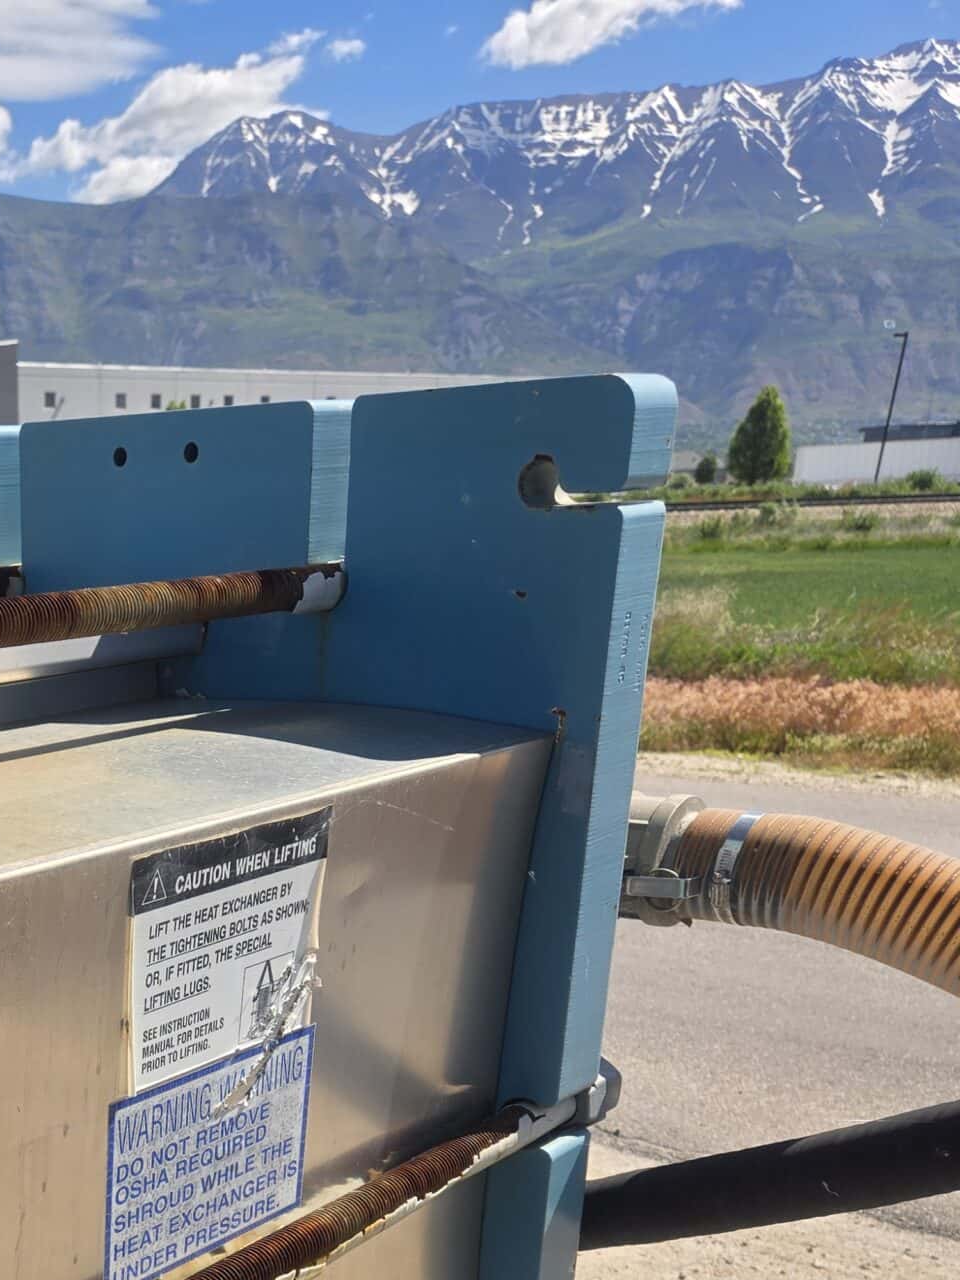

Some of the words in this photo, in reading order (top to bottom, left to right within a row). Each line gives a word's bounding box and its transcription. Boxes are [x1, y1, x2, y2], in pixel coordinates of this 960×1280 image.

[175, 861, 231, 894] CAUTION
[236, 850, 271, 876] WHEN
[274, 837, 316, 864] LIFTING
[147, 944, 166, 963] THE
[170, 925, 226, 956] TIGHTENING
[230, 914, 259, 936] BOLTS
[261, 910, 273, 926] AS
[149, 920, 170, 940] LIFT
[173, 913, 192, 932] THE
[194, 904, 219, 925] HEAT
[221, 886, 278, 916] EXCHANGER
[280, 881, 293, 898] BY
[145, 971, 162, 988] OR,
[165, 965, 174, 981] IF
[177, 953, 212, 977] FITTED,
[215, 945, 233, 963] THE
[235, 932, 272, 957] SPECIAL
[144, 986, 180, 1012] LIFTING
[183, 976, 211, 997] LUGS.
[142, 1037, 174, 1059] MANUAL
[177, 1030, 192, 1046] FOR
[194, 1017, 224, 1039] DETAILS
[143, 1026, 158, 1043] SEE
[160, 1007, 210, 1037] INSTRUCTION
[141, 1055, 166, 1074] PRIOR
[168, 1050, 178, 1064] TO
[180, 1038, 211, 1059] LIFTING.
[118, 1083, 212, 1154] WARNING
[220, 1046, 303, 1103] WNING
[115, 1168, 169, 1205] OSHA
[176, 1125, 266, 1179] REQUIRED
[117, 1157, 144, 1184] DO
[151, 1136, 190, 1168] NOT
[196, 1101, 270, 1149] REMOVE
[114, 1183, 194, 1233] SHROUD
[200, 1154, 255, 1193] WHILE
[261, 1137, 293, 1164] THE
[114, 1223, 162, 1261] HEAT
[169, 1169, 277, 1234] EXCHANGER
[283, 1160, 297, 1180] IS
[184, 1194, 280, 1252] PRESSURE.
